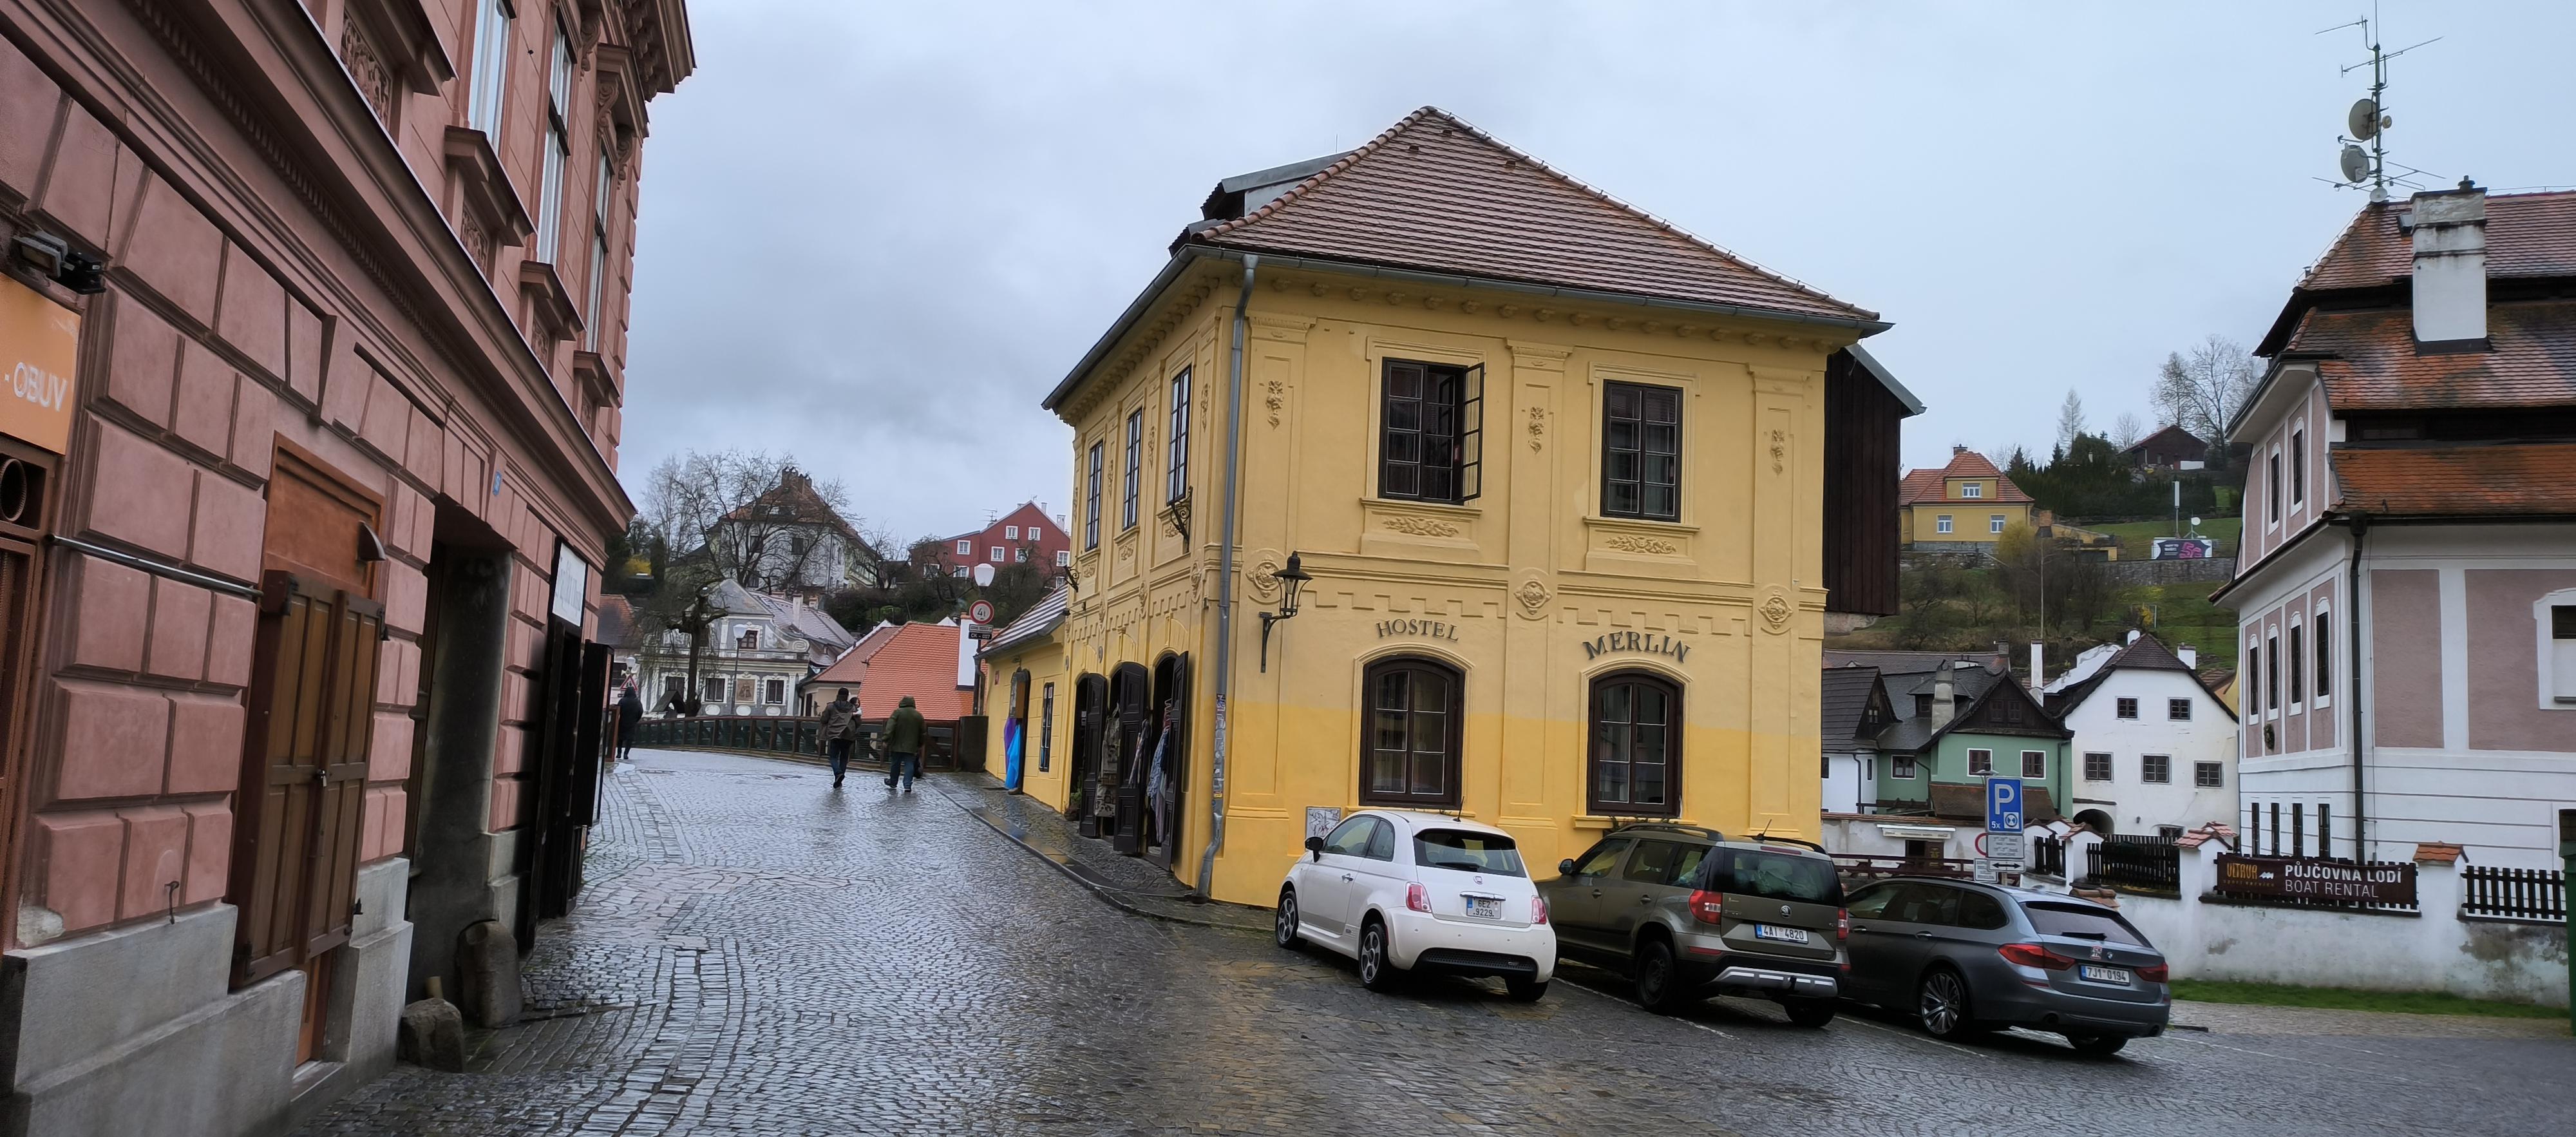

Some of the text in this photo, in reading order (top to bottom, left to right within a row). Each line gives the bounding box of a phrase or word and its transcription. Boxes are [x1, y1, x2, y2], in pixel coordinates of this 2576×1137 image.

[13, 361, 68, 413] OBUV
[1375, 618, 1692, 664] HOSTEL MERLIN
[1994, 783, 2015, 815] P
[2285, 861, 2402, 883] PŮJČOVNA LODÍ
[2286, 879, 2380, 898] BOAT RENTAL
[1475, 908, 1493, 917] 9229
[1478, 900, 1491, 908] 6E2
[1785, 928, 1804, 940] 4820
[2107, 970, 2126, 981] 0194
